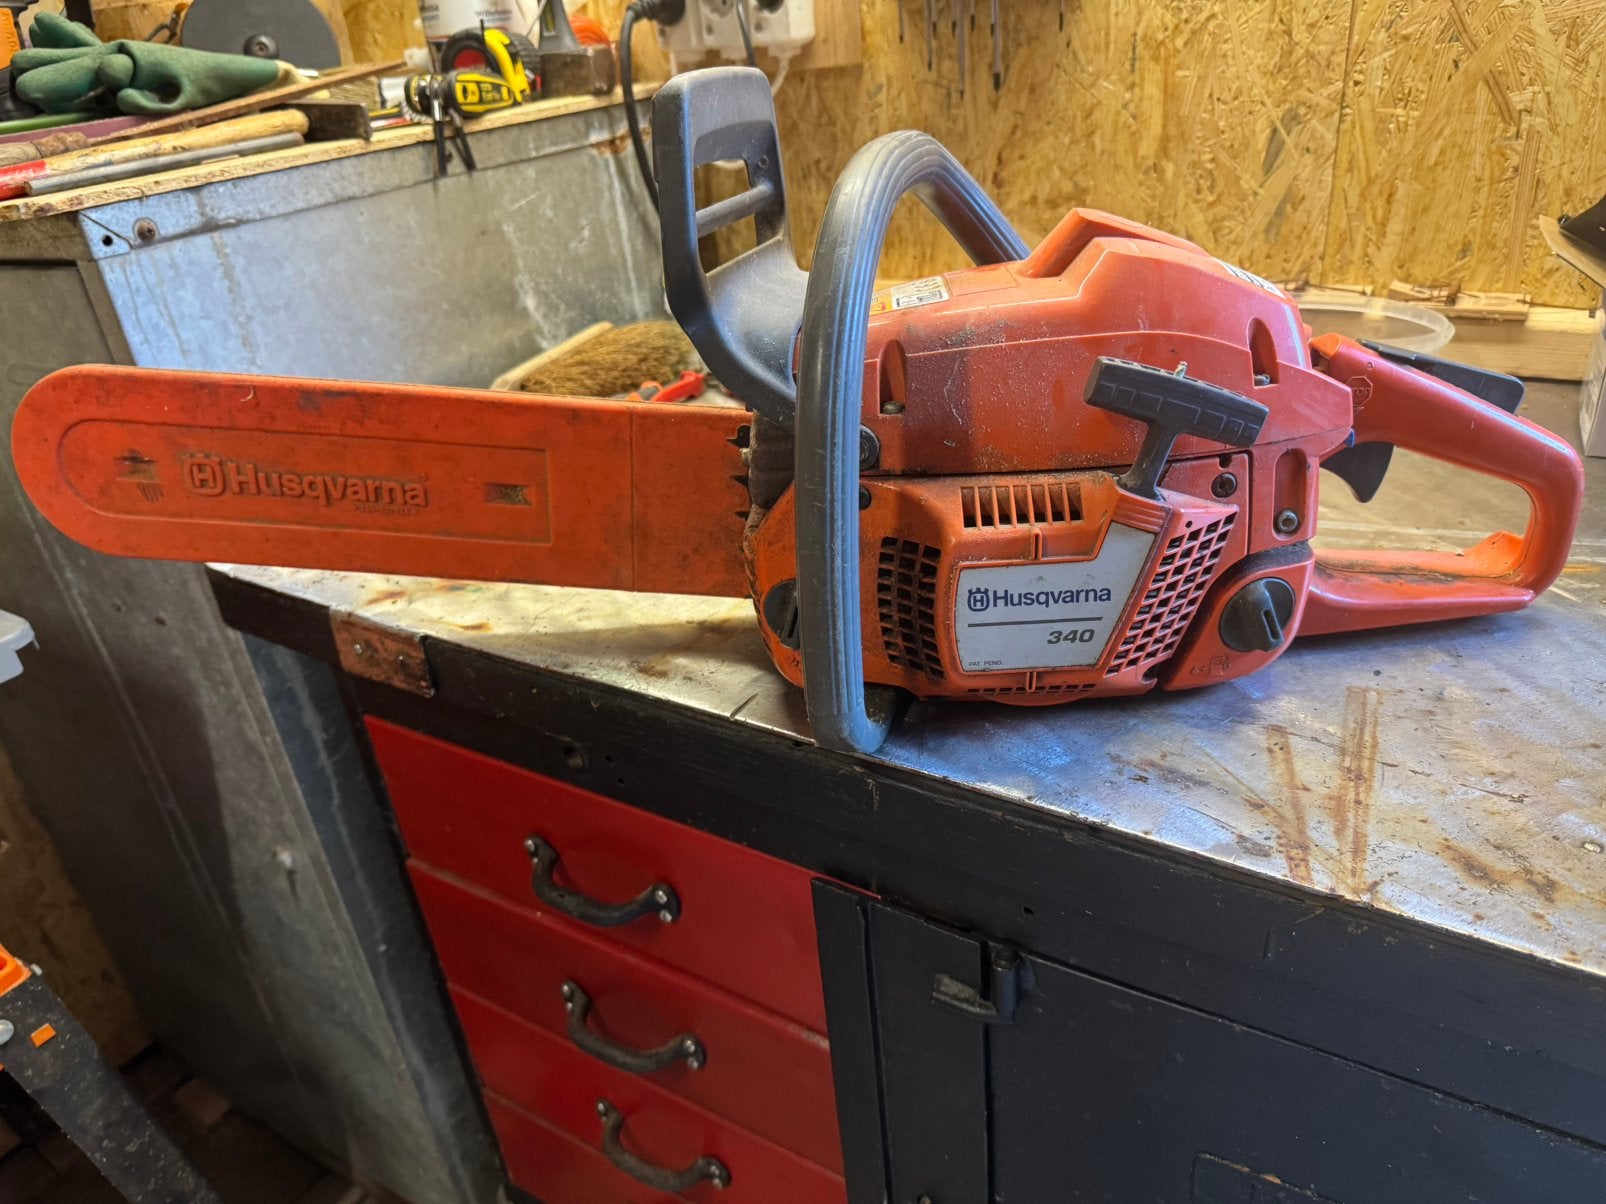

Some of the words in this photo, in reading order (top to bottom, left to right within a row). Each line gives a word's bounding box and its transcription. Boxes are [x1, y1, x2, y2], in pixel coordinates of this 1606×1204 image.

[1351, 387, 1371, 396] TOP
[226, 462, 428, 507] Husqvarna
[992, 588, 1111, 608] Husqvarna
[1047, 629, 1095, 645] 340
